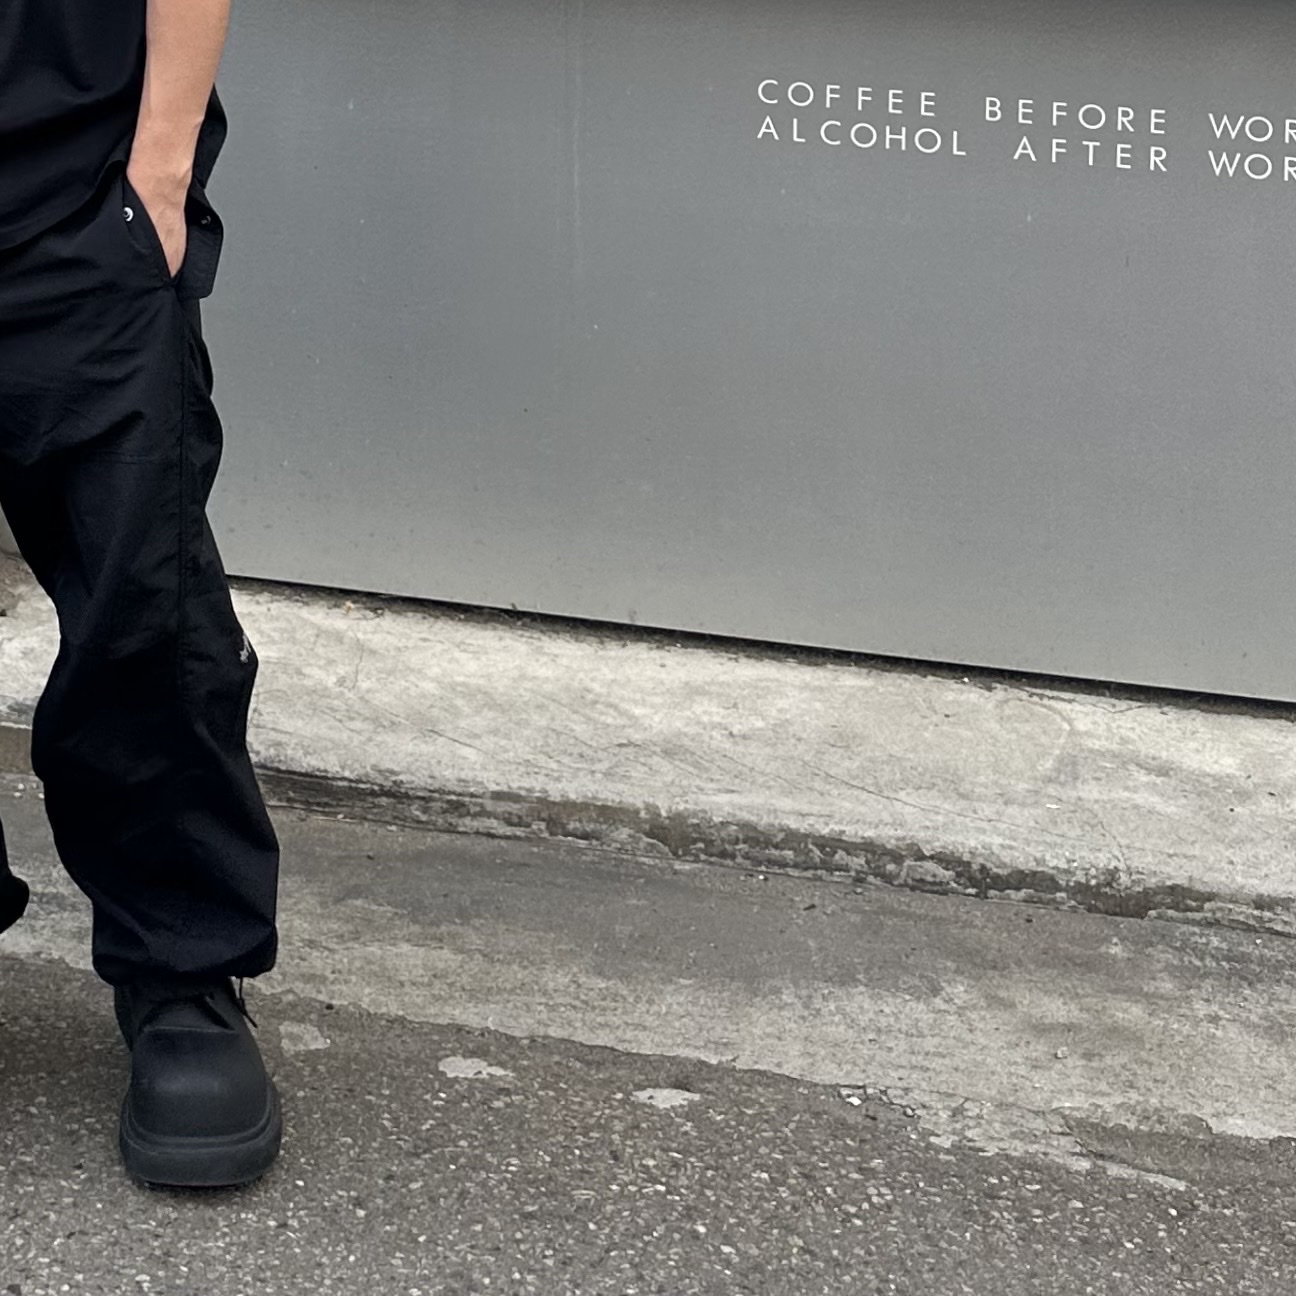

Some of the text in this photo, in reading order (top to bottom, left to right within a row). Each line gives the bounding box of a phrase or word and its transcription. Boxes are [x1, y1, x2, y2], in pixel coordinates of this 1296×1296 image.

[757, 79, 936, 116] COFFEE
[985, 96, 1166, 135] BEFORE
[756, 115, 967, 156] ALCOHOL
[1013, 135, 1168, 172] AFTER
